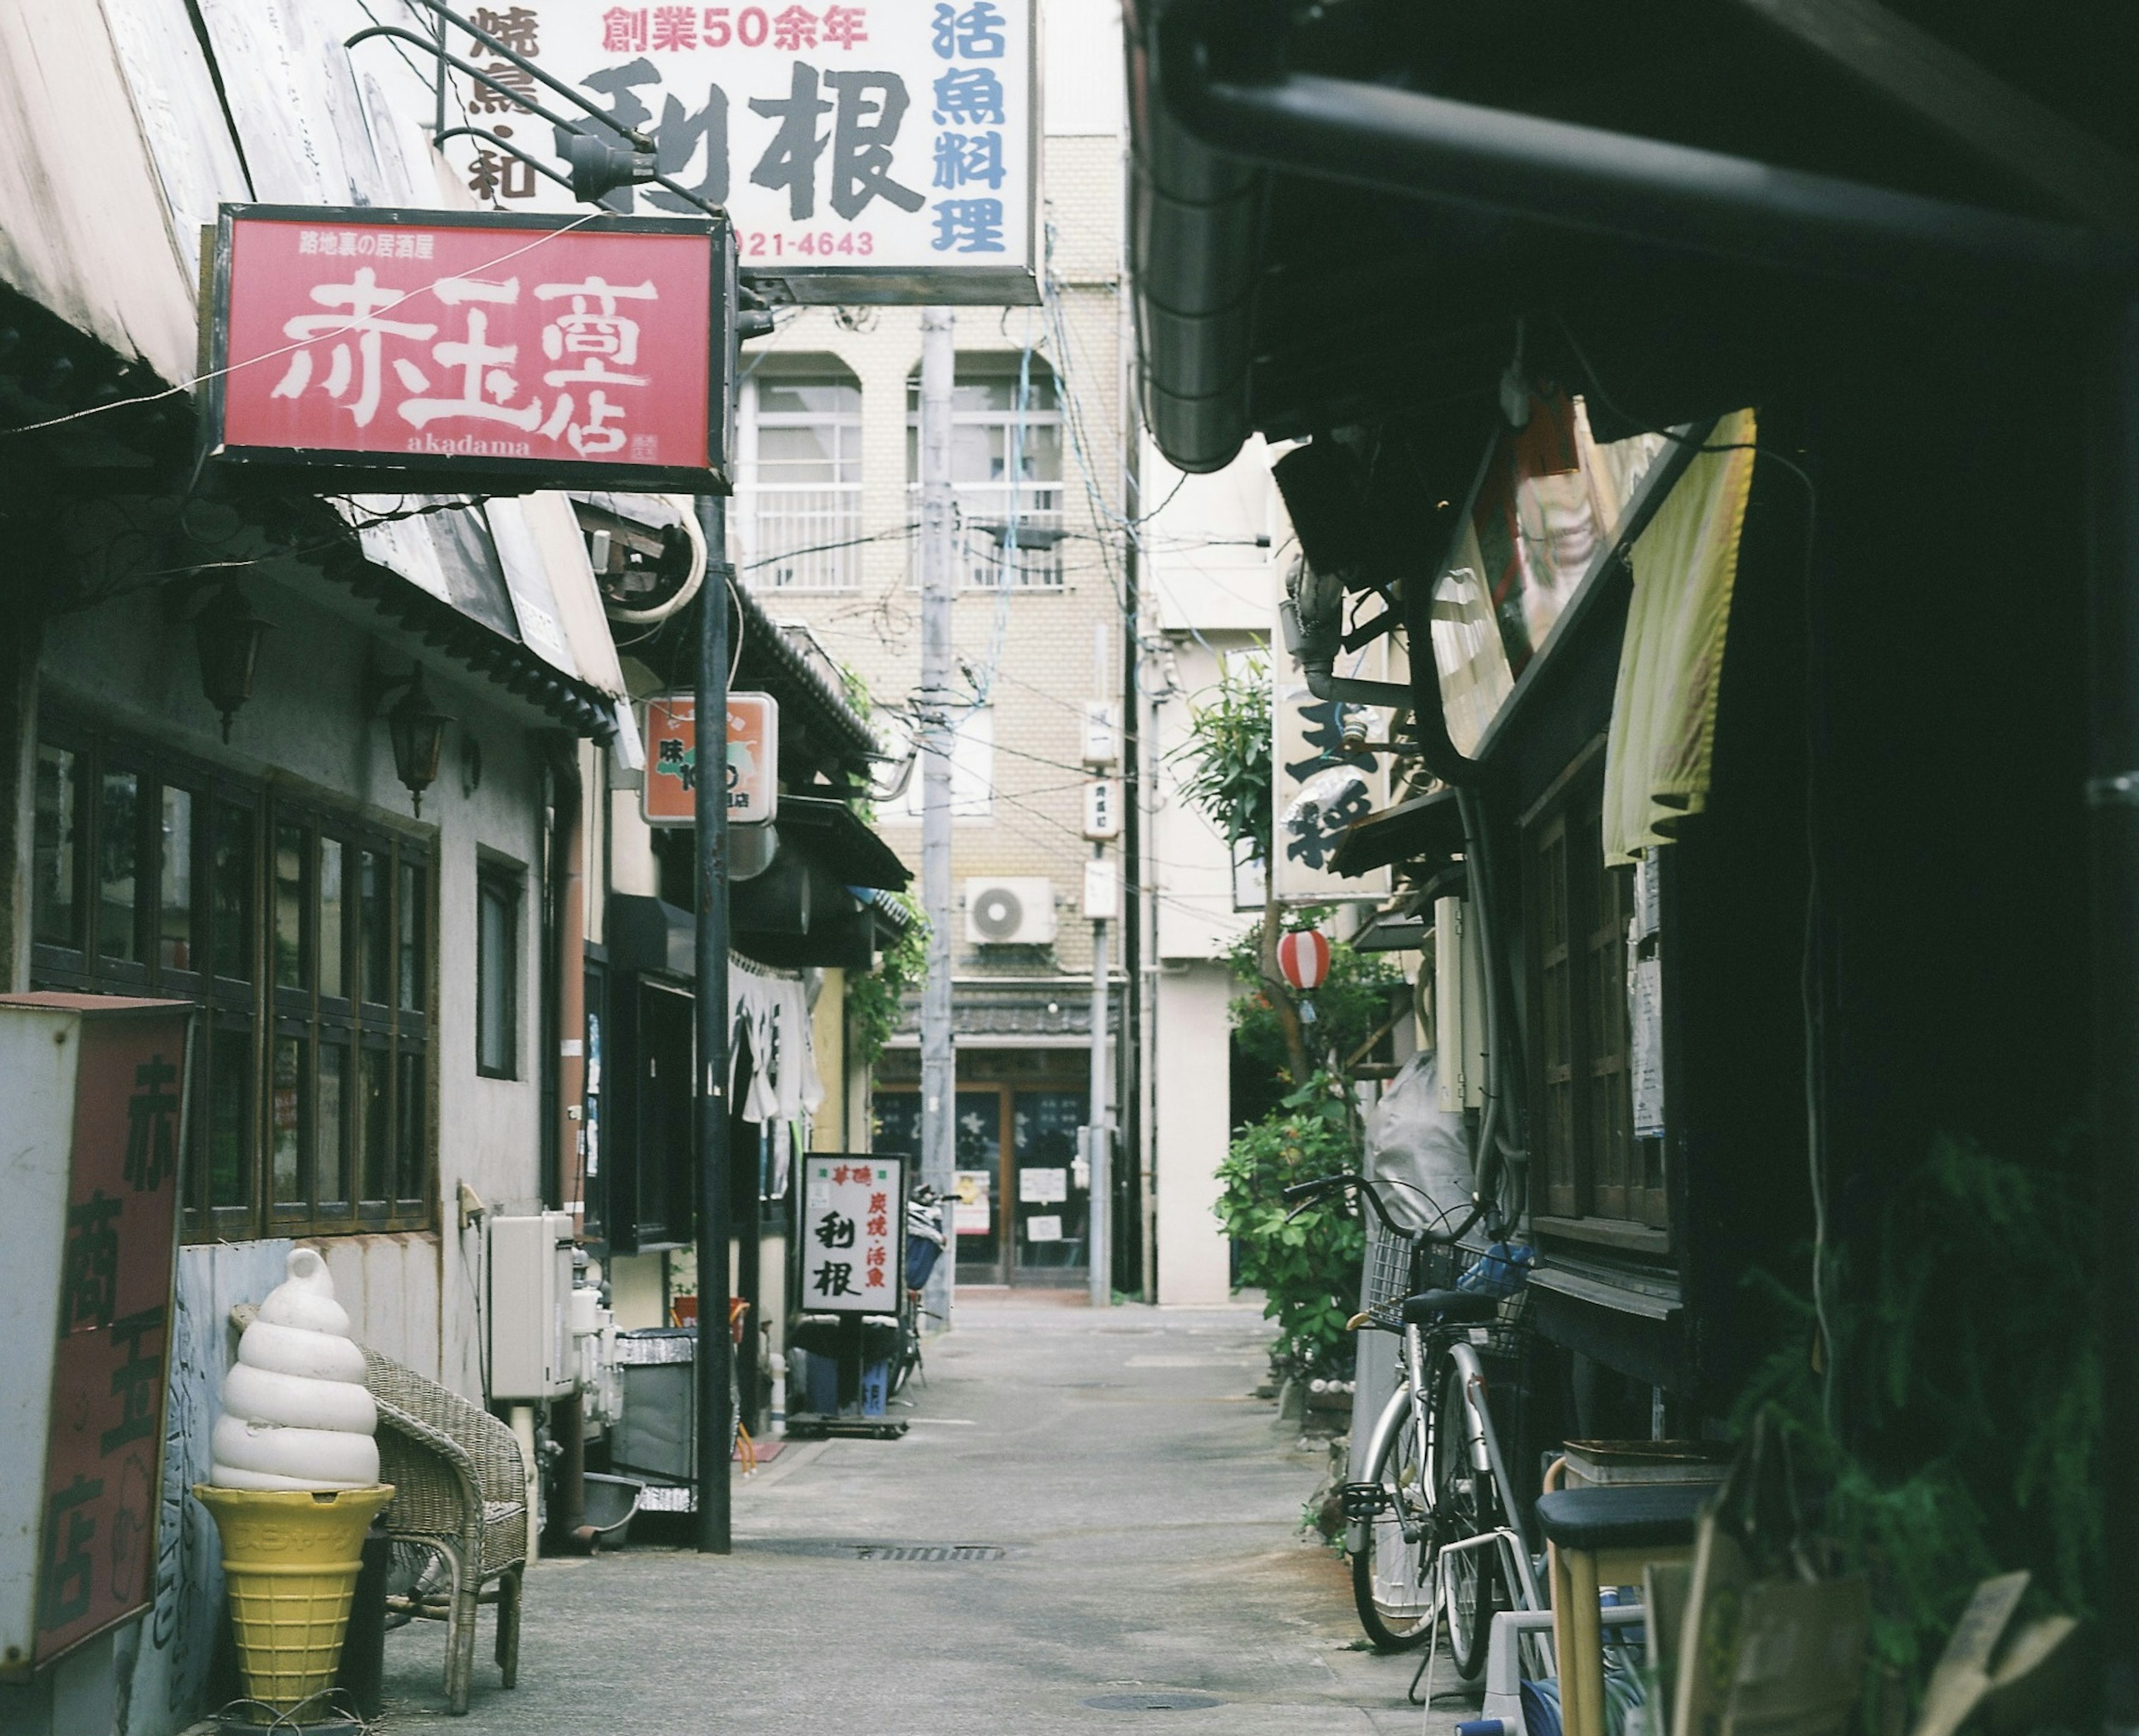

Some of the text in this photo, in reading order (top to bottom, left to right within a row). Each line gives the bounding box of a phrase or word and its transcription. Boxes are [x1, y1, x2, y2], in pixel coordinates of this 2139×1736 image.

[601, 5, 868, 52] 創業50余年
[468, 7, 539, 210] 焼鳥・和
[553, 57, 926, 221] 利根
[930, 1, 1006, 253] 活魚料理
[299, 231, 434, 260] 路地裏の居酒屋
[408, 433, 530, 456] akadama
[814, 1210, 862, 1297] 利根
